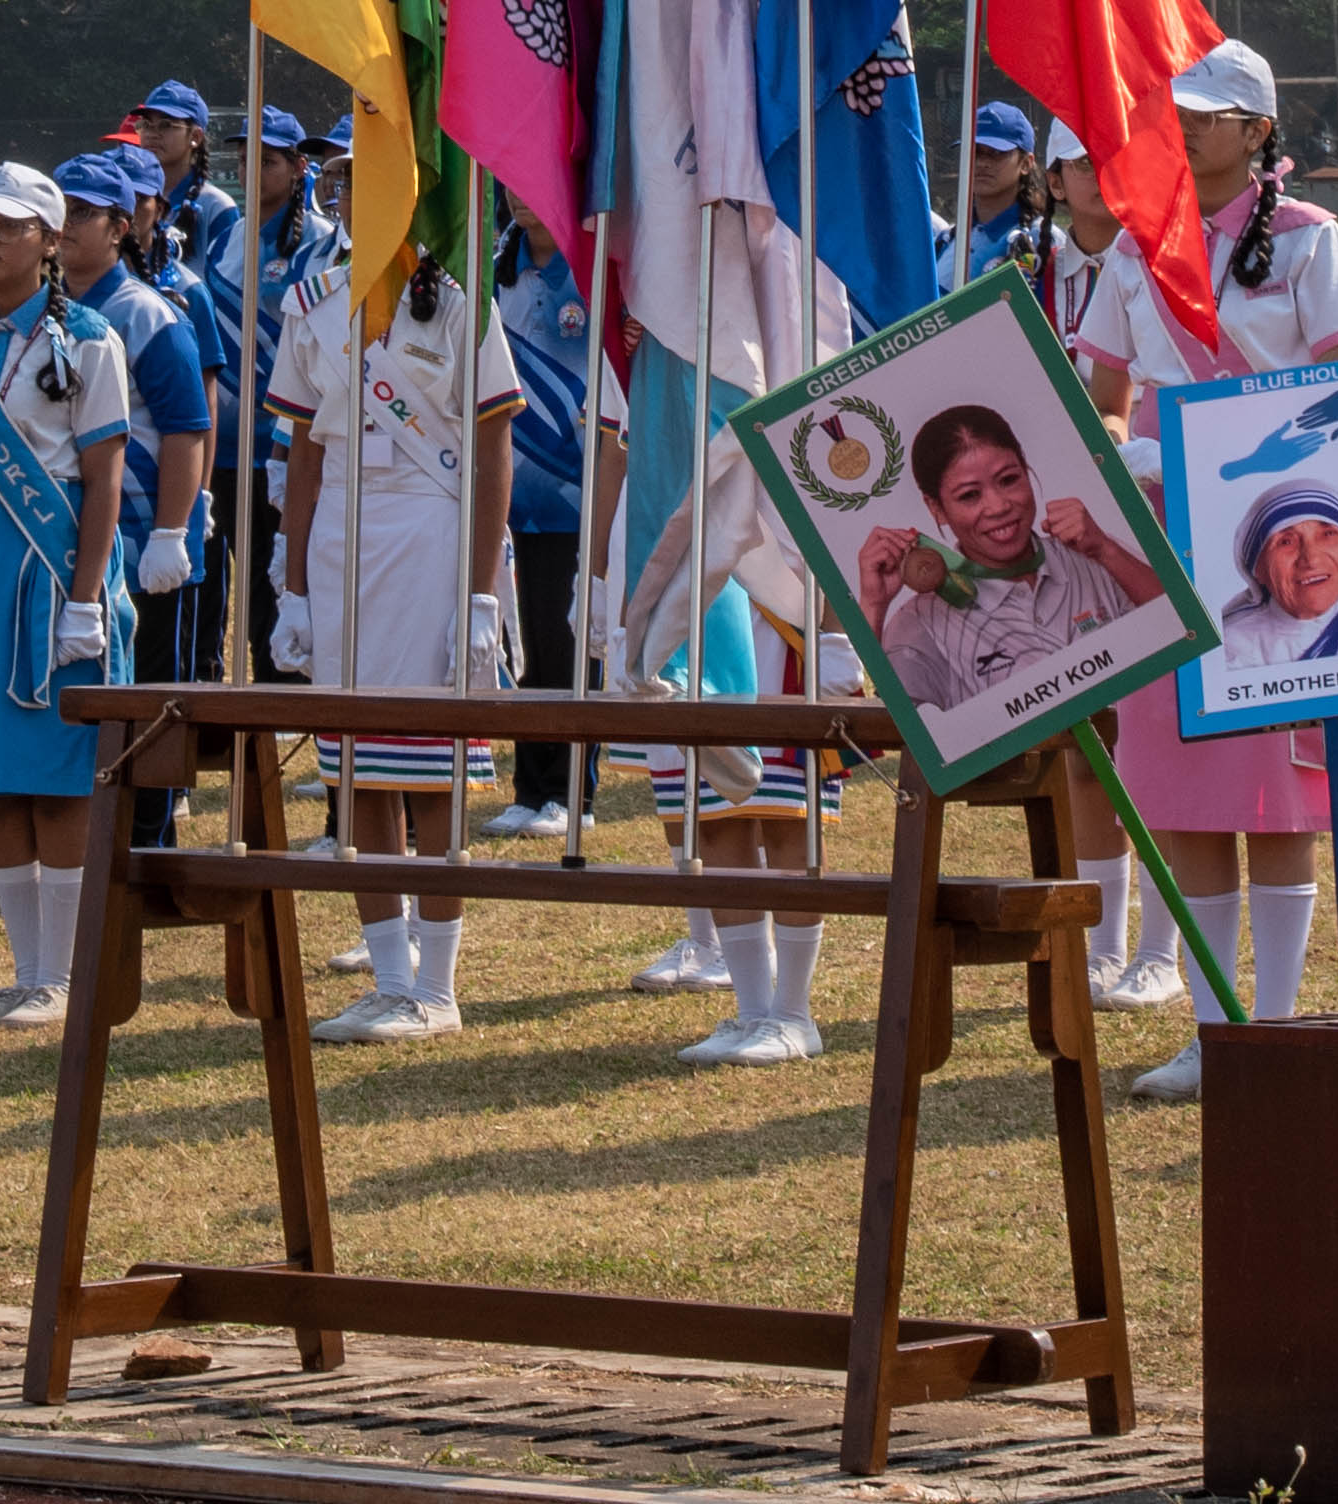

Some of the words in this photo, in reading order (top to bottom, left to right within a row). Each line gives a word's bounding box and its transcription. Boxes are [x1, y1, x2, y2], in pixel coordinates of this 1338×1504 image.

[806, 350, 878, 398] GREEN
[878, 310, 952, 360] HOUSE
[1241, 372, 1295, 393] BLUE
[1004, 675, 1061, 718] MARY
[1064, 649, 1114, 685] KOM
[1227, 685, 1257, 701] ST.
